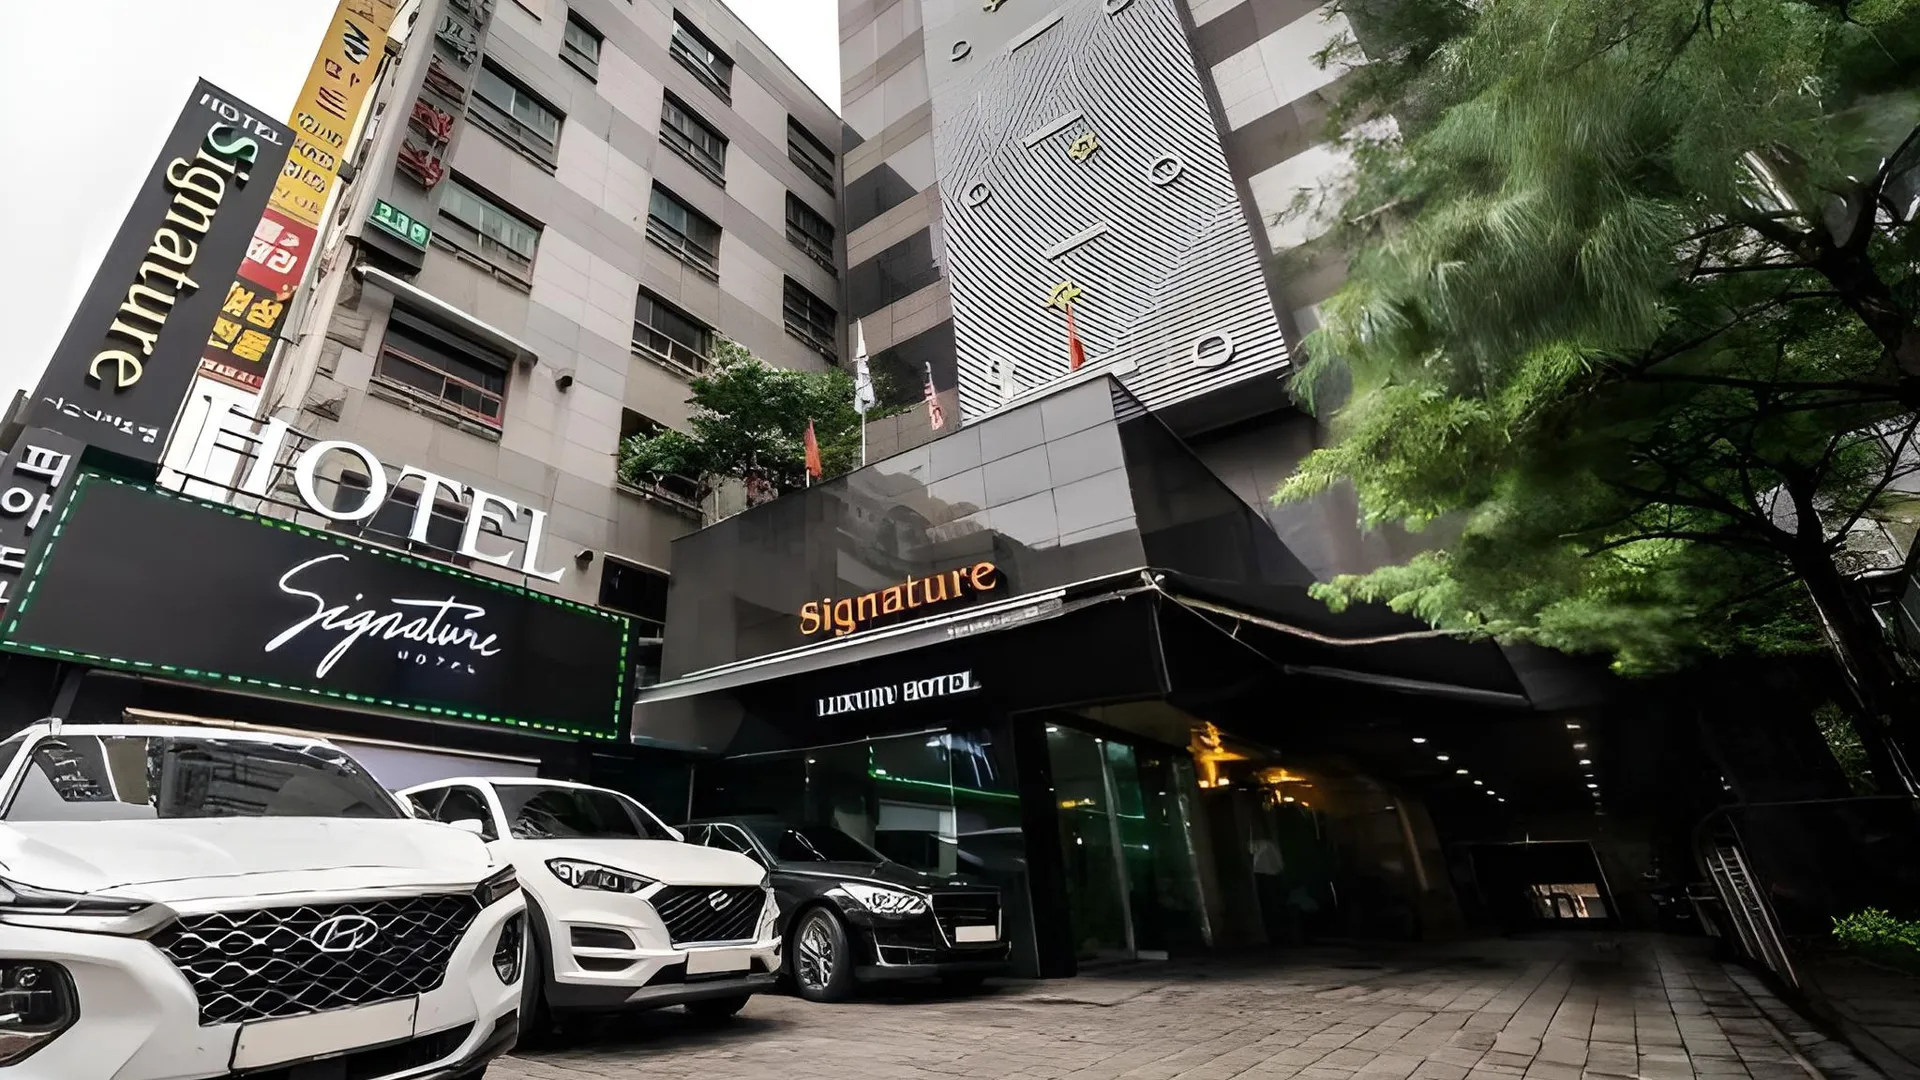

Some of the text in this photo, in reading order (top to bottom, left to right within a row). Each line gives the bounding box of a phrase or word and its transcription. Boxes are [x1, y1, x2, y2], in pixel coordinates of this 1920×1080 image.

[88, 121, 259, 389] Signature
[192, 394, 567, 584] HOTEL
[265, 554, 501, 679] Signature
[800, 561, 997, 636] Signature
